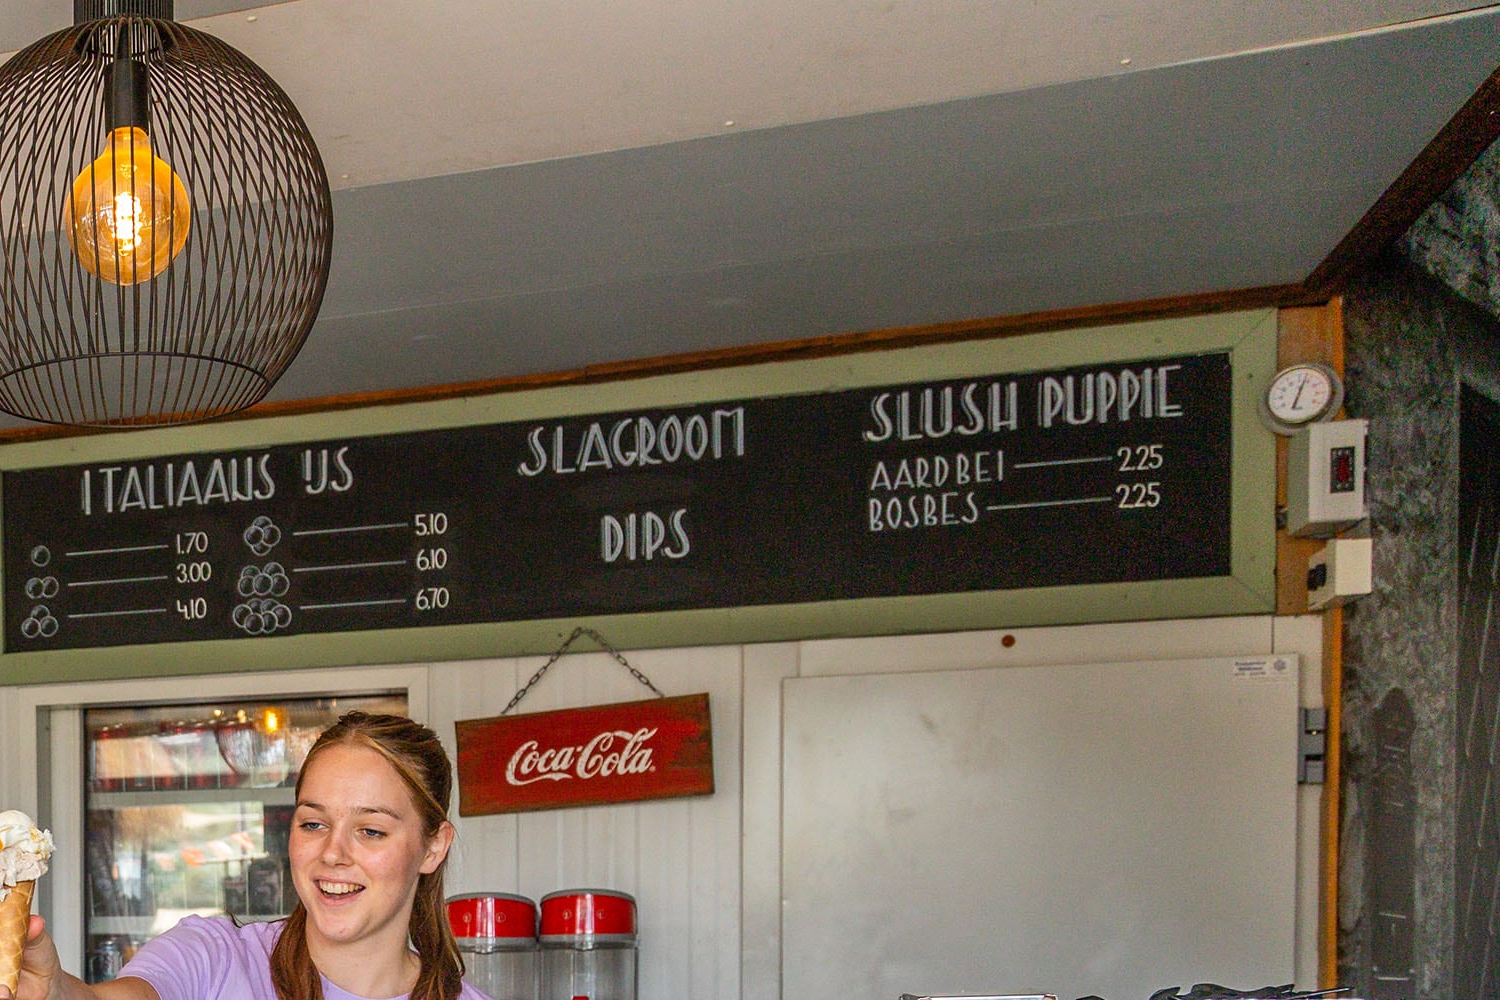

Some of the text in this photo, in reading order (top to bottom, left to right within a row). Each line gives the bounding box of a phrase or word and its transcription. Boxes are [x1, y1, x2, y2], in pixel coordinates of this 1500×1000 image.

[862, 364, 1183, 442] SLUSH PUPPIE
[518, 406, 744, 477] SLAGROOM
[81, 454, 276, 515] ITALIAANS
[870, 450, 1004, 491] AARDBEI
[414, 512, 448, 536] 5.10
[869, 492, 980, 532] BOSBES
[176, 531, 209, 554] 1.70
[601, 508, 691, 562] DIPS
[176, 561, 212, 583] 3.00
[416, 547, 448, 571] 6.10
[176, 597, 208, 620] 4.10
[415, 587, 450, 610] 6.70
[505, 727, 659, 786] Coca-Cola
